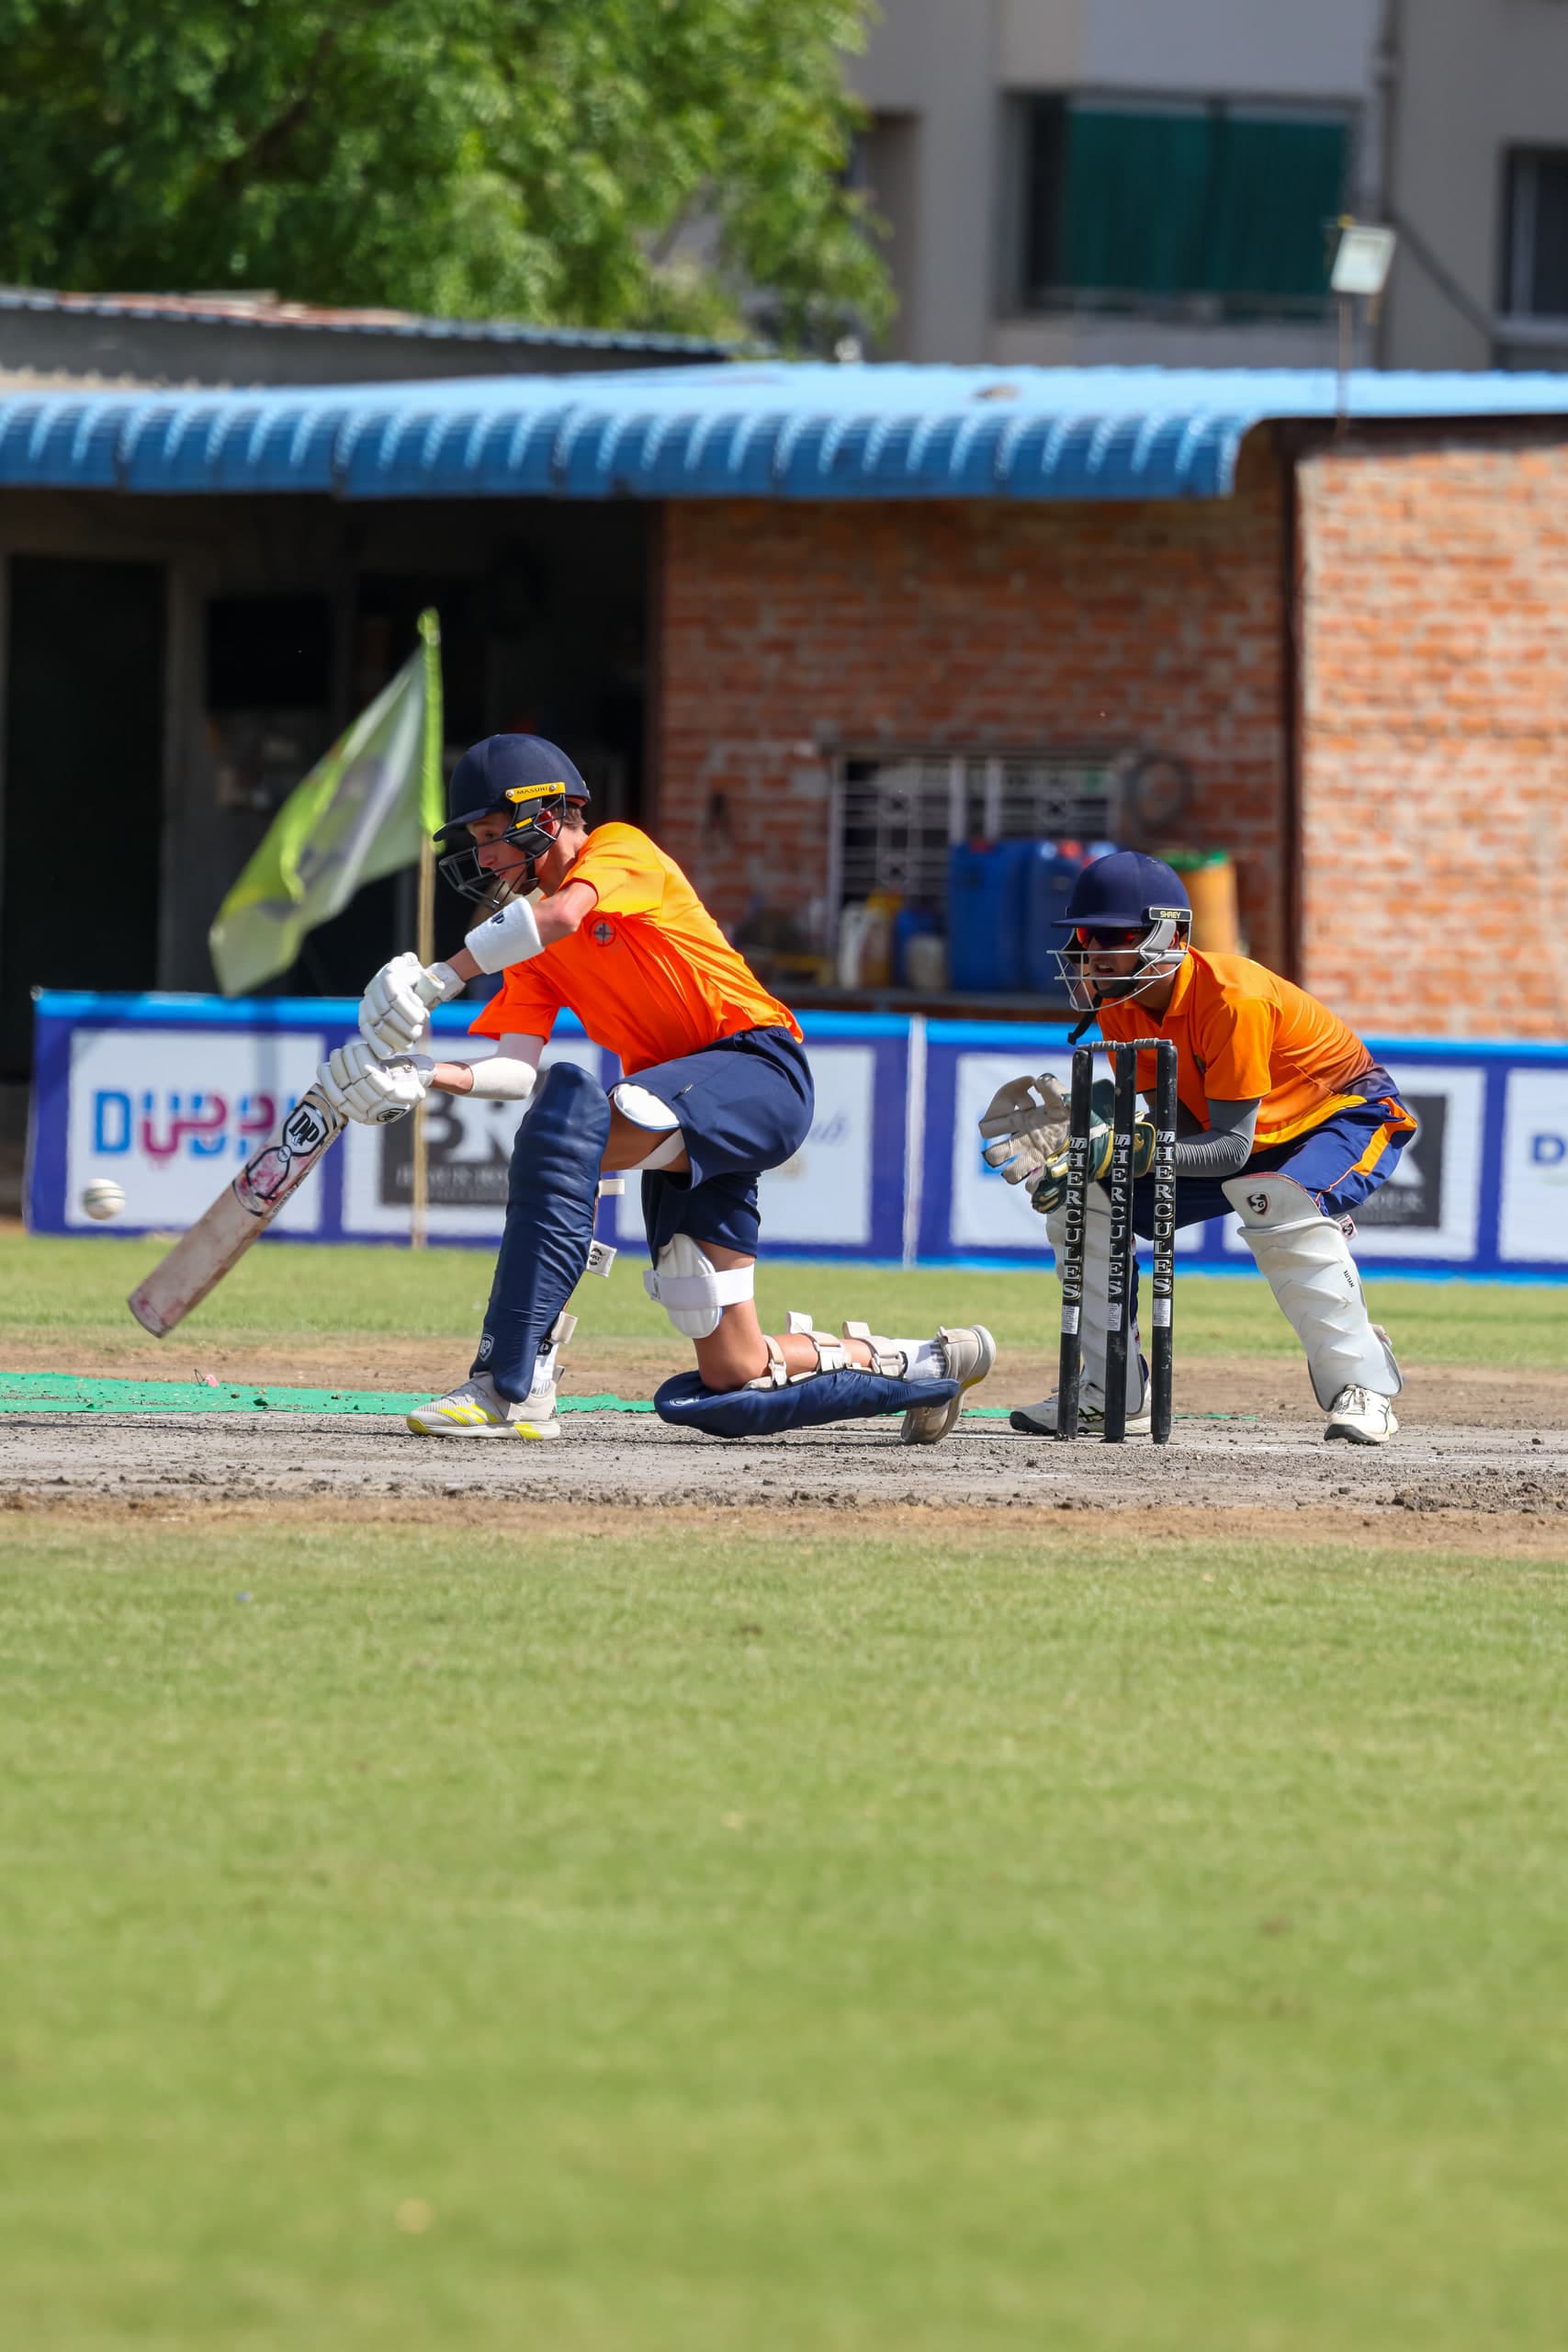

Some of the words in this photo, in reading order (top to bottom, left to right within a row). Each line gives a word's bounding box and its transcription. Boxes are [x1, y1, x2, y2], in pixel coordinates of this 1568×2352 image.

[1159, 910, 1180, 919] SHREY
[1063, 1152, 1086, 1300] HERCULES
[1109, 1148, 1129, 1295] HERCULES
[1154, 1146, 1174, 1295] HERCULES
